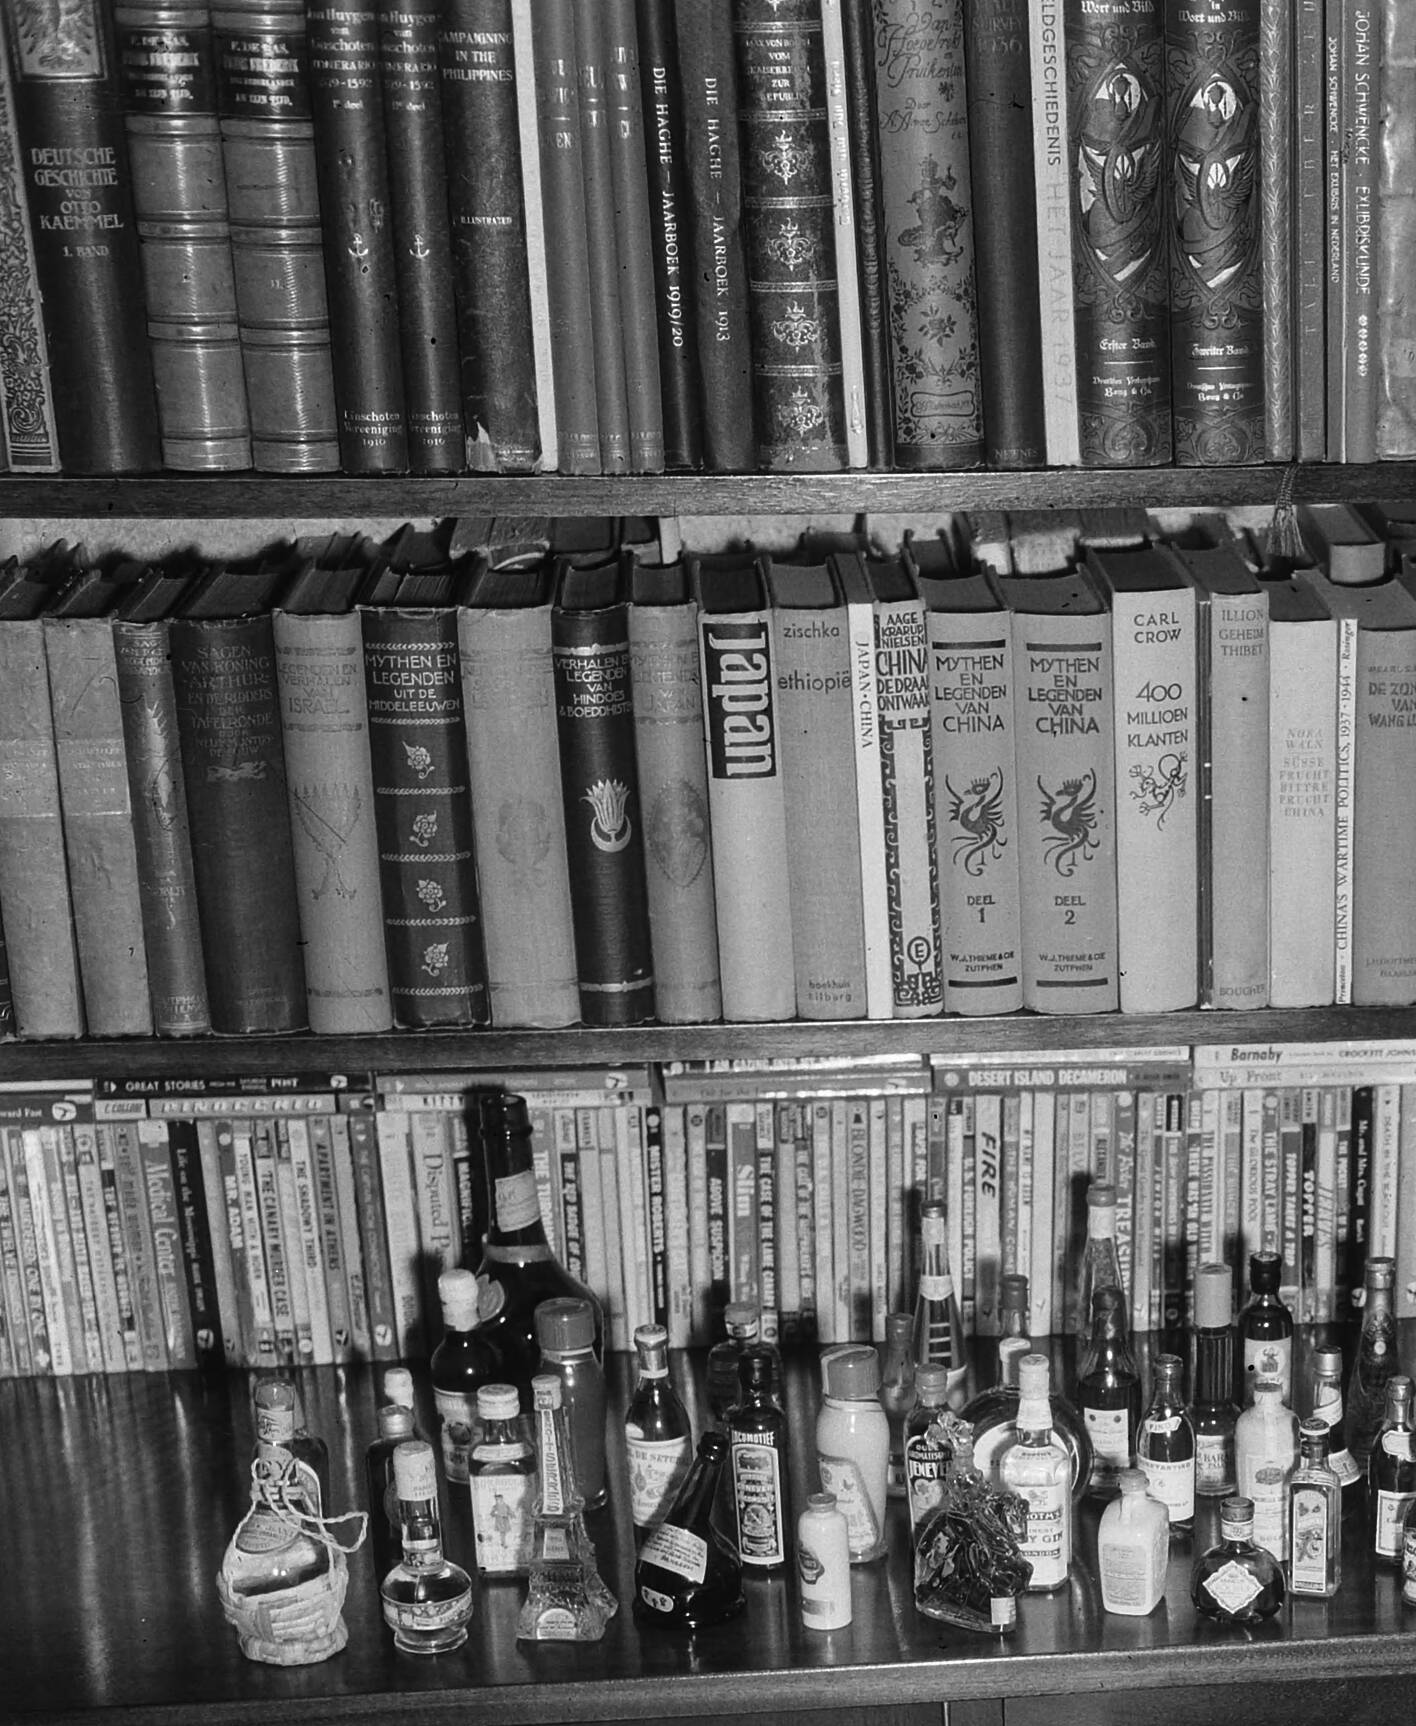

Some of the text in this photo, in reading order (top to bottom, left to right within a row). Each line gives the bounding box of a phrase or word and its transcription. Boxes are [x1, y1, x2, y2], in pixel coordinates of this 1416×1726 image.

[472, 51, 496, 63] THE
[1328, 36, 1338, 72] JOHAN
[443, 69, 513, 81] PHILIPPINES
[704, 78, 719, 105] DIE
[31, 148, 116, 165] DEUTSCHE
[707, 119, 722, 179] HAGHE
[1355, 11, 1371, 297] JOHAN SCHWENCKE EXLIBRISKUNDE
[34, 167, 118, 186] GESCHICHTE
[65, 188, 91, 200] VON
[1329, 171, 1340, 210] EXLIBRIS
[60, 200, 101, 214] OTTO
[653, 66, 684, 347] DIE HAGHE JAARBOEK 1919/20
[40, 214, 124, 230] KAEMMEL
[1331, 214, 1340, 225] IN
[712, 215, 729, 297] JAARBOEK
[887, 611, 918, 625] AAGE
[1134, 611, 1180, 627] CARL
[783, 621, 840, 639] zischka
[881, 624, 924, 637] KRARUP
[1134, 629, 1181, 645] CROW
[881, 636, 925, 649] NIELSEN
[365, 653, 457, 669] MYTHEN EN
[556, 656, 619, 671] VERHALEN
[936, 654, 1004, 672] MYTHEN
[1030, 656, 1099, 673] MYTHEN
[373, 670, 455, 686] LEGENDEN
[566, 668, 628, 683] LEGENDEN
[778, 669, 851, 695] ethiopië
[960, 673, 983, 686] EN
[1054, 675, 1078, 688] EN
[394, 688, 436, 699] UIT DE
[587, 681, 612, 693] VAN
[856, 641, 874, 748] JAPAN CHINA
[935, 685, 1007, 701] LEGENDEN
[1028, 688, 1102, 702] LEGENDEN
[1136, 680, 1182, 702] 400
[1369, 682, 1387, 696] DE
[369, 698, 460, 713] MIDDELEEUWEN
[573, 691, 625, 706] HINDOES
[709, 631, 772, 776] Japan
[955, 702, 990, 715] VAN
[1048, 703, 1083, 716] VAN
[1127, 707, 1188, 726] MILLIOEN
[943, 715, 1005, 733] CHINA
[1036, 716, 1099, 735] CHINA
[1127, 729, 1188, 748] KLANTEN
[1338, 741, 1350, 809] POLITICS,
[1338, 814, 1349, 886] WARTIME
[967, 895, 996, 906] DEEL
[1055, 895, 1086, 906] DEEL
[1064, 910, 1076, 925] 2
[965, 964, 1003, 973] ZUTPHEN
[1054, 964, 1093, 973] ZUTPHEN
[808, 991, 852, 1002] tilburg
[1231, 1047, 1283, 1064] Barnaby
[1339, 1047, 1384, 1058] CROCKETT
[125, 1081, 160, 1092] GREAT
[164, 1079, 206, 1091] STORIES
[969, 1068, 1128, 1087] DESERT ISLAND DECAMERON
[1220, 1069, 1283, 1086] Up Front
[981, 1131, 997, 1199] FIRE
[1264, 1132, 1278, 1232] THE STRAY LAMB
[424, 1153, 449, 1228] Disputed
[710, 1177, 723, 1215] ABOVE
[737, 1164, 755, 1217] Slim
[649, 1145, 664, 1253] MISTER ROBERTS
[1303, 1170, 1315, 1237] TOPPER
[145, 1160, 178, 1277] Medical Center
[325, 1213, 336, 1226] IN
[228, 1207, 244, 1249] ADAM
